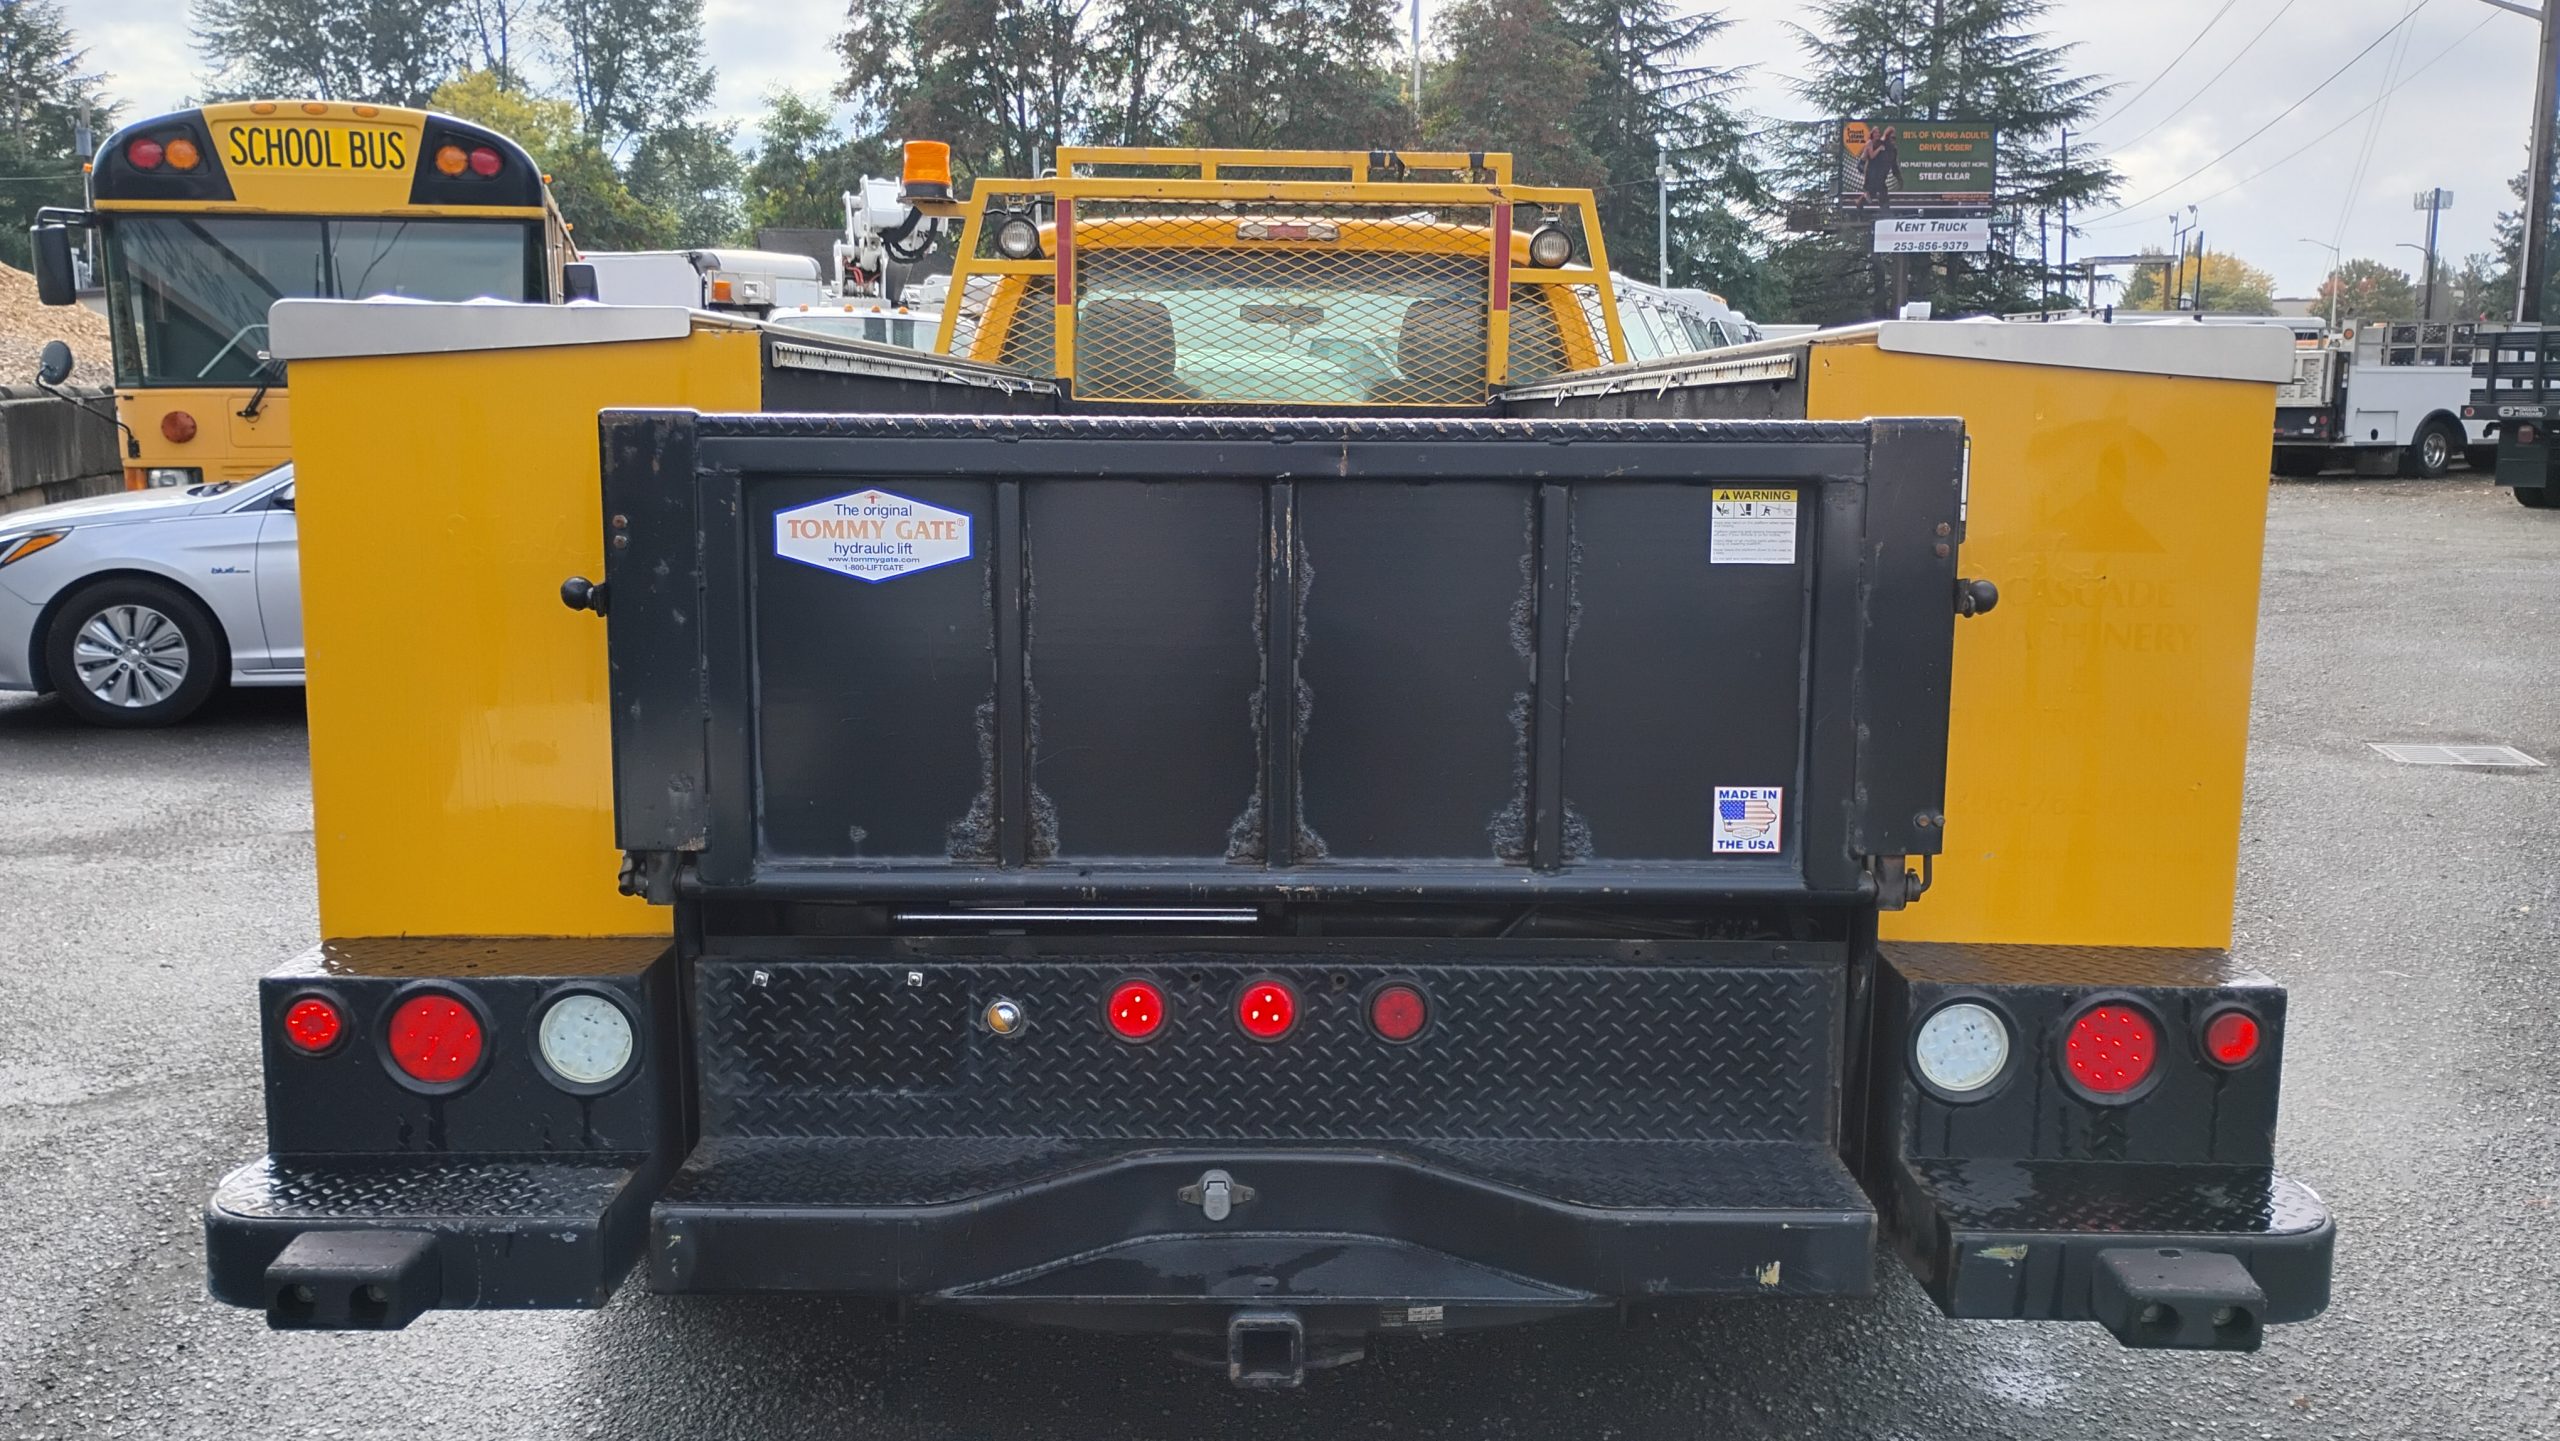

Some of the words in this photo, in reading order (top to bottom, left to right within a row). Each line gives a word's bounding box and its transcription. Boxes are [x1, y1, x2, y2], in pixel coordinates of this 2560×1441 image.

[1919, 131, 1929, 139] OF
[1931, 131, 1958, 139] YOUNG
[1960, 131, 1989, 139] ADULTS
[229, 126, 342, 167] SCHOOL
[349, 131, 405, 169] BUS
[1895, 221, 1926, 232] KENT
[1931, 221, 1968, 232] TRUCK
[1893, 241, 1969, 251] 253-856-9379
[1733, 491, 1791, 500] WARNING
[834, 504, 859, 516] The
[863, 504, 912, 519] original
[788, 520, 885, 540] TOMMY
[834, 542, 894, 556] hydraulic
[897, 542, 912, 554] lift
[1719, 790, 1757, 799] MADE
[1763, 790, 1777, 799] IN
[1717, 841, 1744, 849] THE
[1748, 841, 1775, 850] USA
